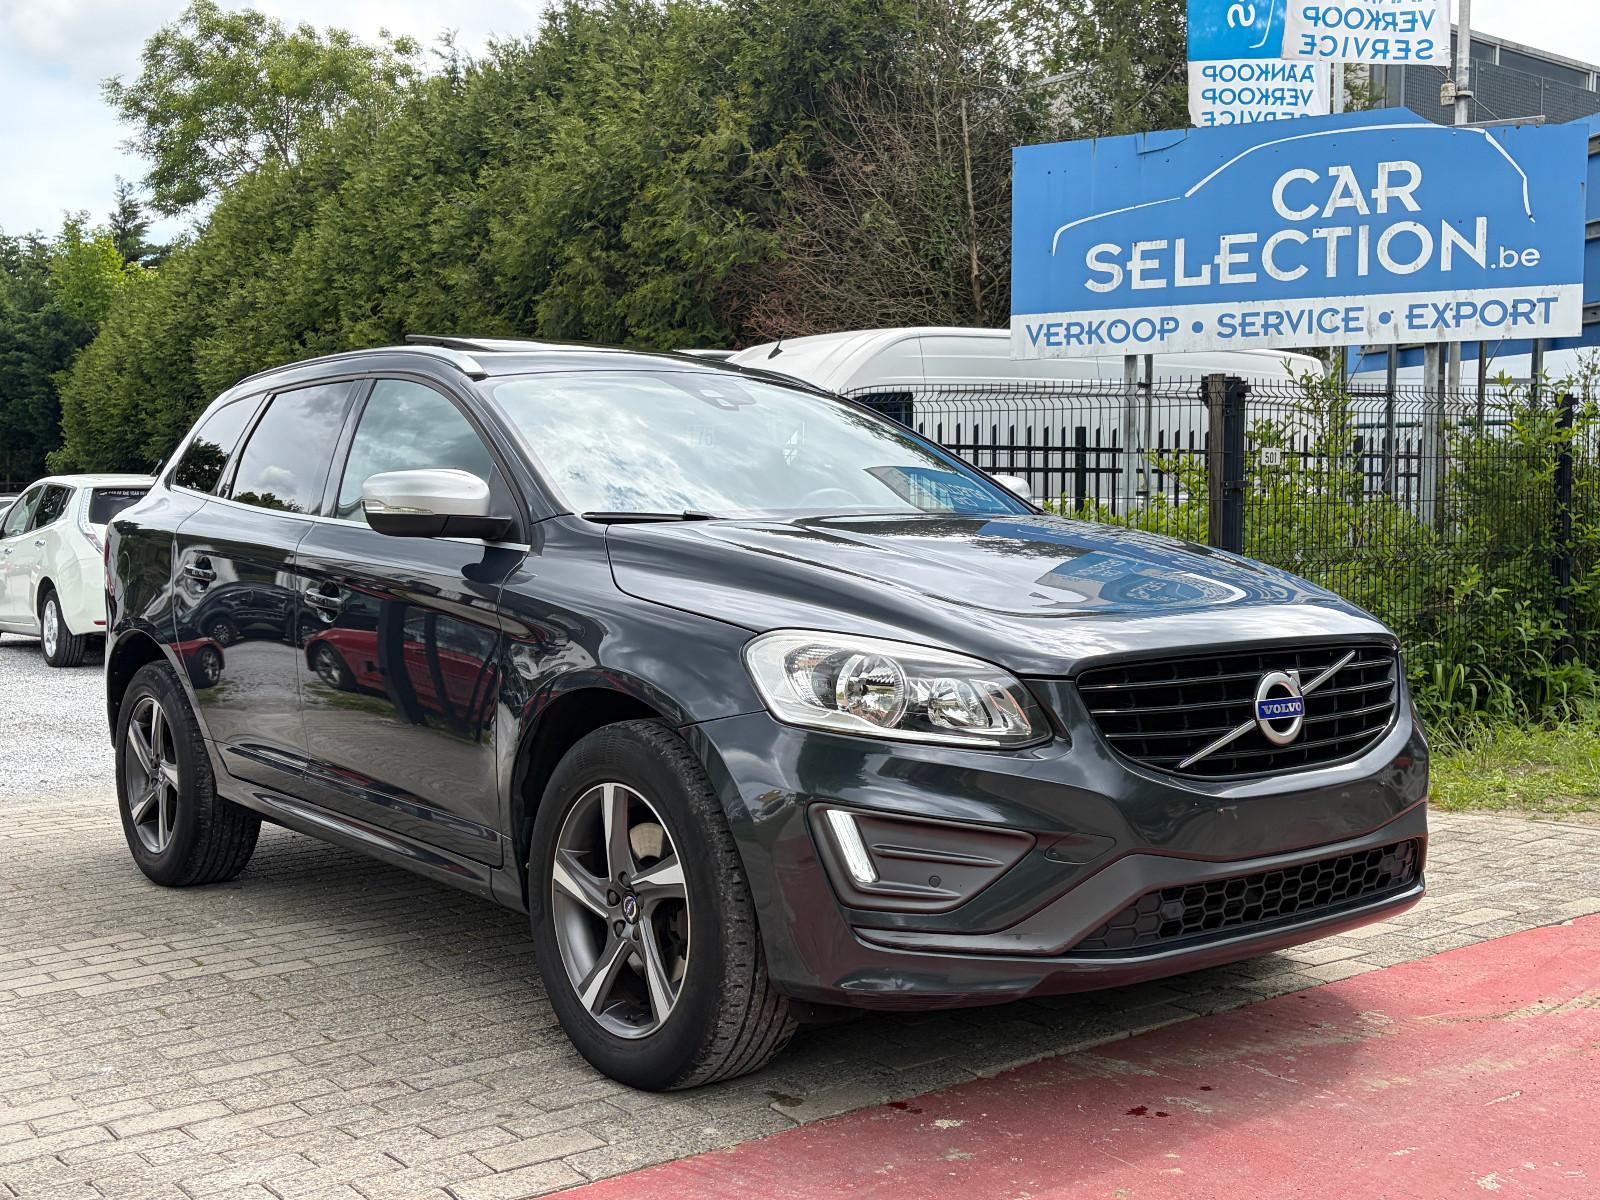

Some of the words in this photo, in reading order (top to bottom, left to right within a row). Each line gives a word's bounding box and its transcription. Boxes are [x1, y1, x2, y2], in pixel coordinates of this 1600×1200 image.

[1271, 160, 1422, 221] CAR
[1025, 316, 1180, 348] VERKOOP
[1216, 306, 1364, 339] SERVICE
[1405, 296, 1559, 330] EXPORT
[1264, 451, 1277, 464] 501
[1261, 702, 1302, 715] VOLVO
